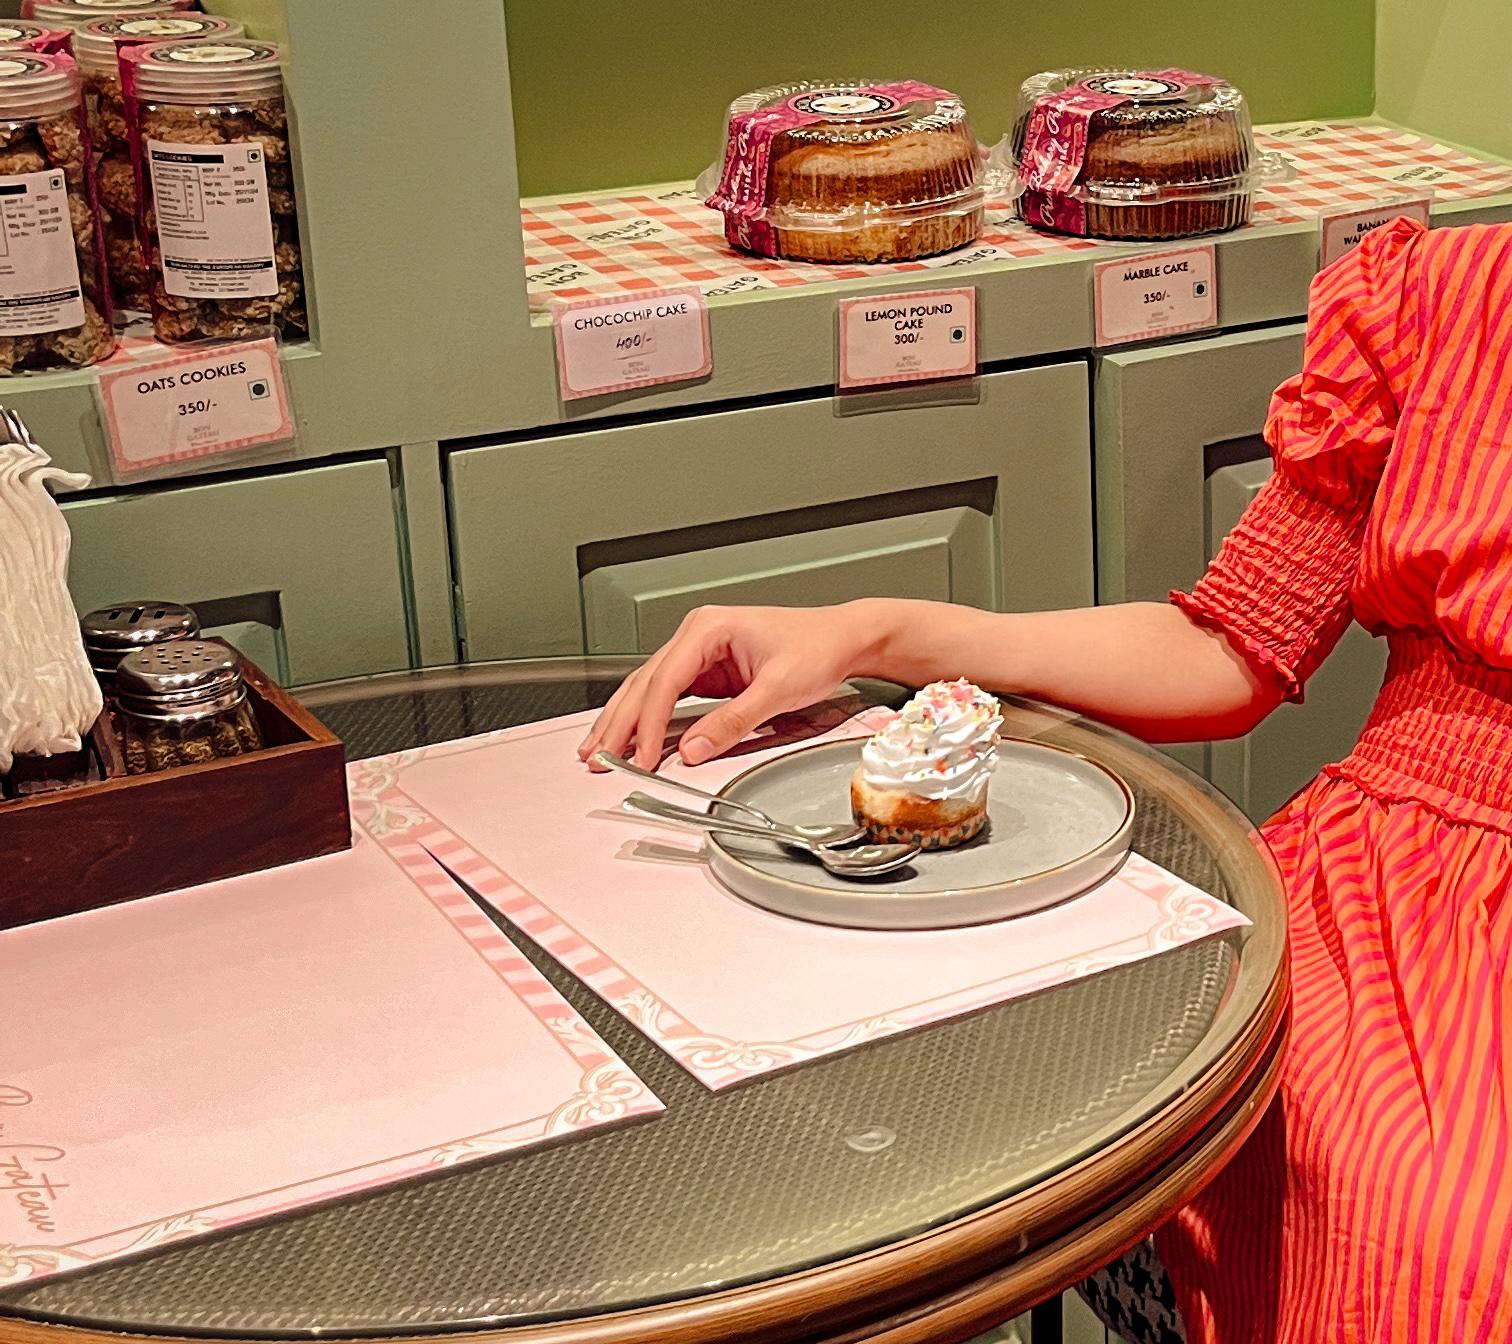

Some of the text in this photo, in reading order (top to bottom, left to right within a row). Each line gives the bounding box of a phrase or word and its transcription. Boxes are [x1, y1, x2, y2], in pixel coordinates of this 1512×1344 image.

[1123, 261, 1188, 281] MARBLE CAKE
[1143, 290, 1171, 304] 350/-
[574, 303, 688, 331] CHOCOCHIP CAKE
[865, 303, 953, 322] LEMON POUND
[894, 318, 924, 331] CAKE
[615, 332, 652, 350] 400/-
[894, 332, 924, 345] 300/-
[137, 361, 247, 394] OATS COOKIES
[178, 399, 218, 416] 350/-
